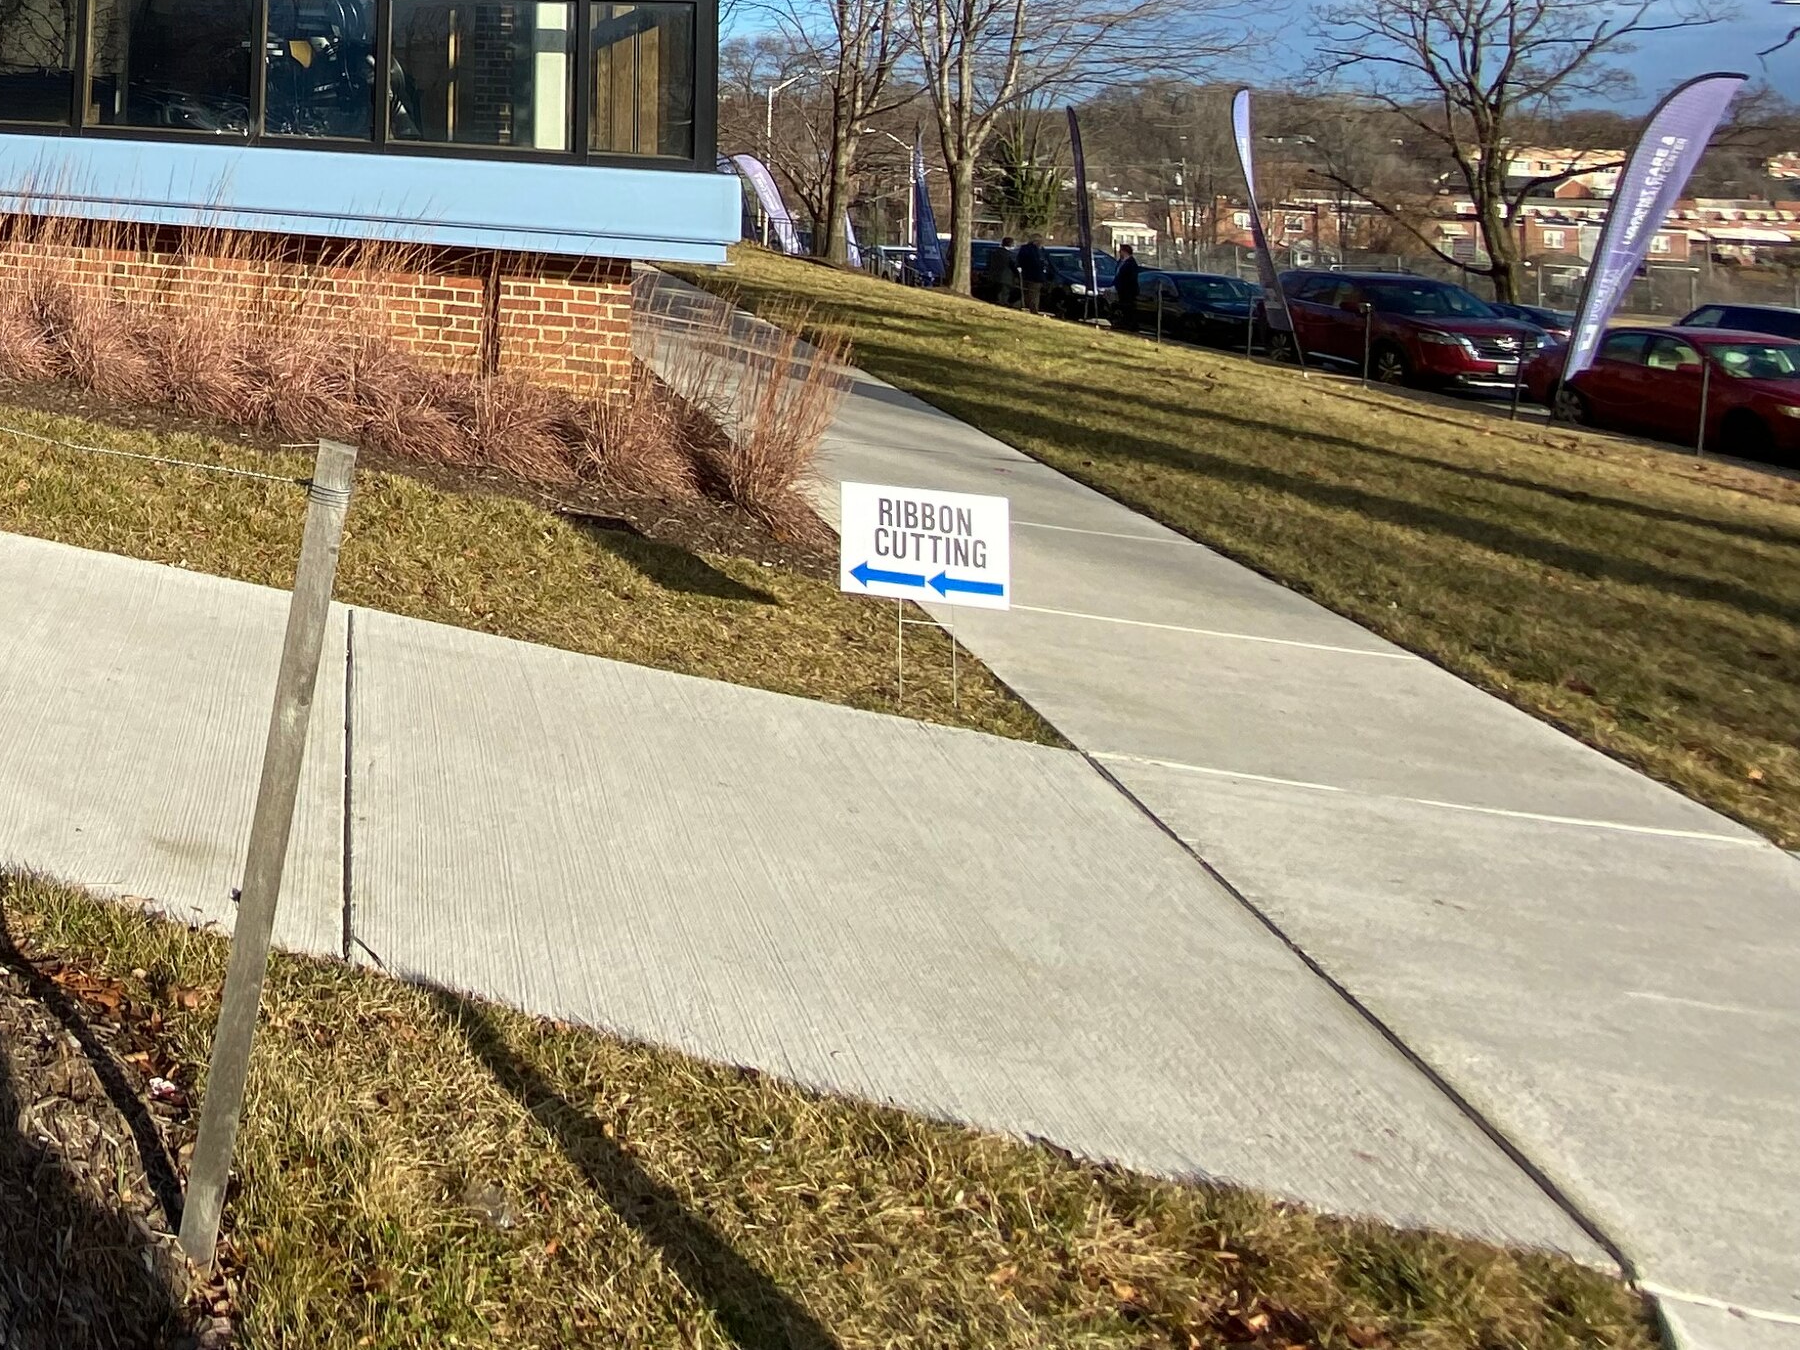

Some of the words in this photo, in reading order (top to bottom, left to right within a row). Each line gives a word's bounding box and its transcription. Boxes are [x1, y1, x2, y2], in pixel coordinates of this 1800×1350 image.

[1645, 149, 1669, 186] CARE
[878, 497, 973, 537] RIBBON
[874, 527, 987, 569] CUTTING
